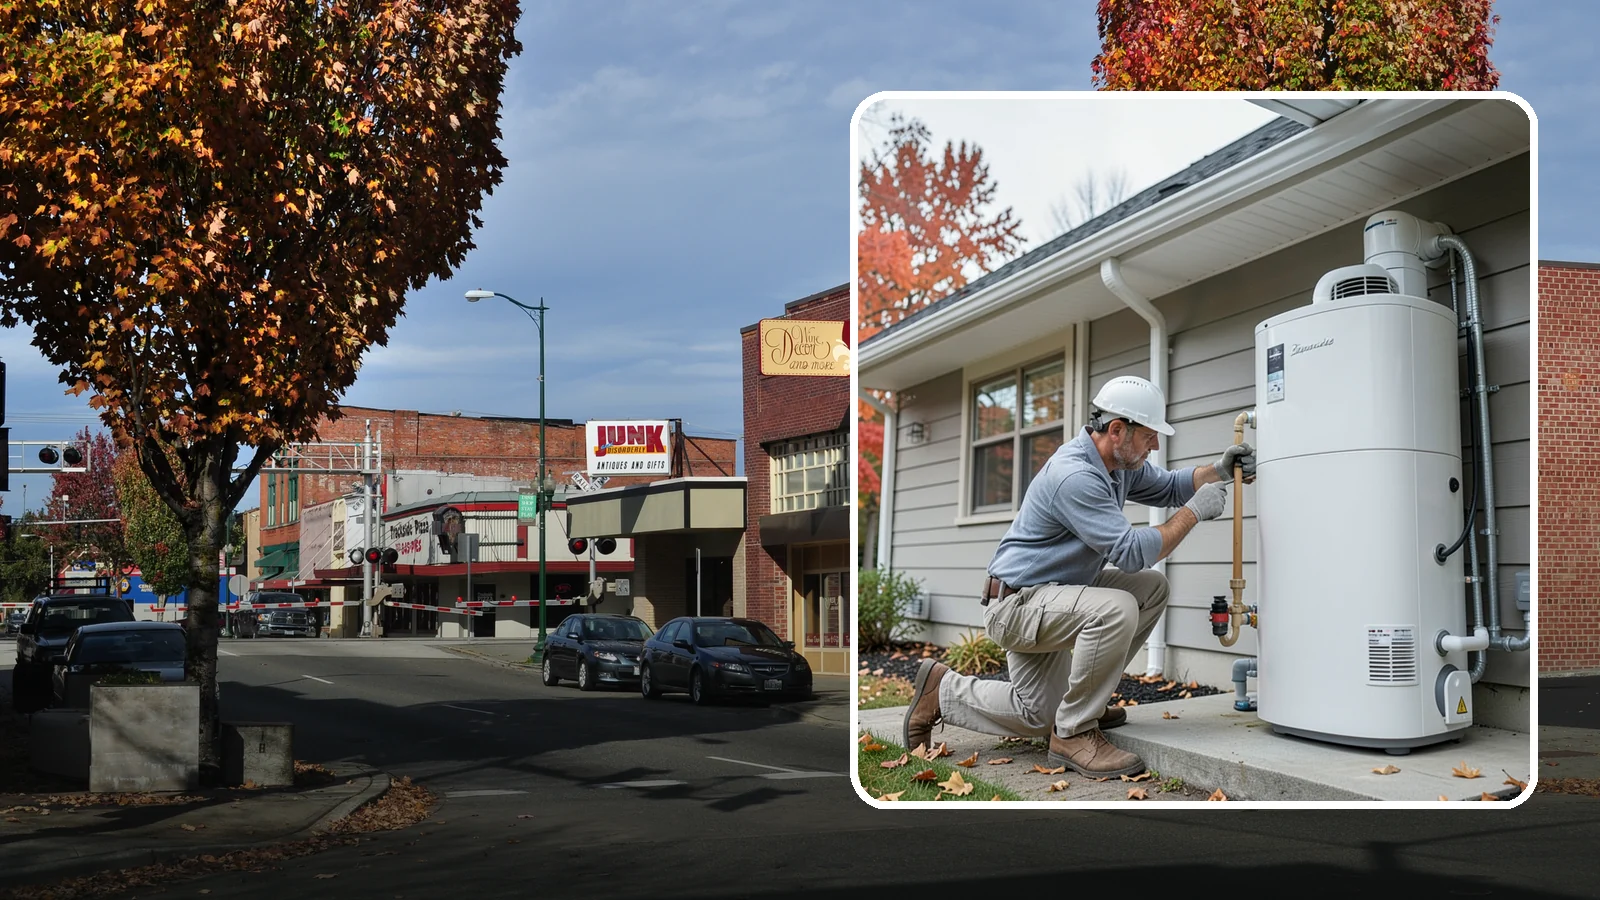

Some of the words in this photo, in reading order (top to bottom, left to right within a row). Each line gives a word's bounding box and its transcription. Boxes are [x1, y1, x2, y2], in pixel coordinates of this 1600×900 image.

[596, 425, 664, 457] JUNK
[607, 446, 646, 454] DISORDERLY
[597, 461, 628, 470] ANTIQUES
[631, 461, 643, 469] AND
[647, 460, 665, 469] GIFTS
[390, 521, 413, 540] Trackside
[414, 519, 429, 535] Pizza
